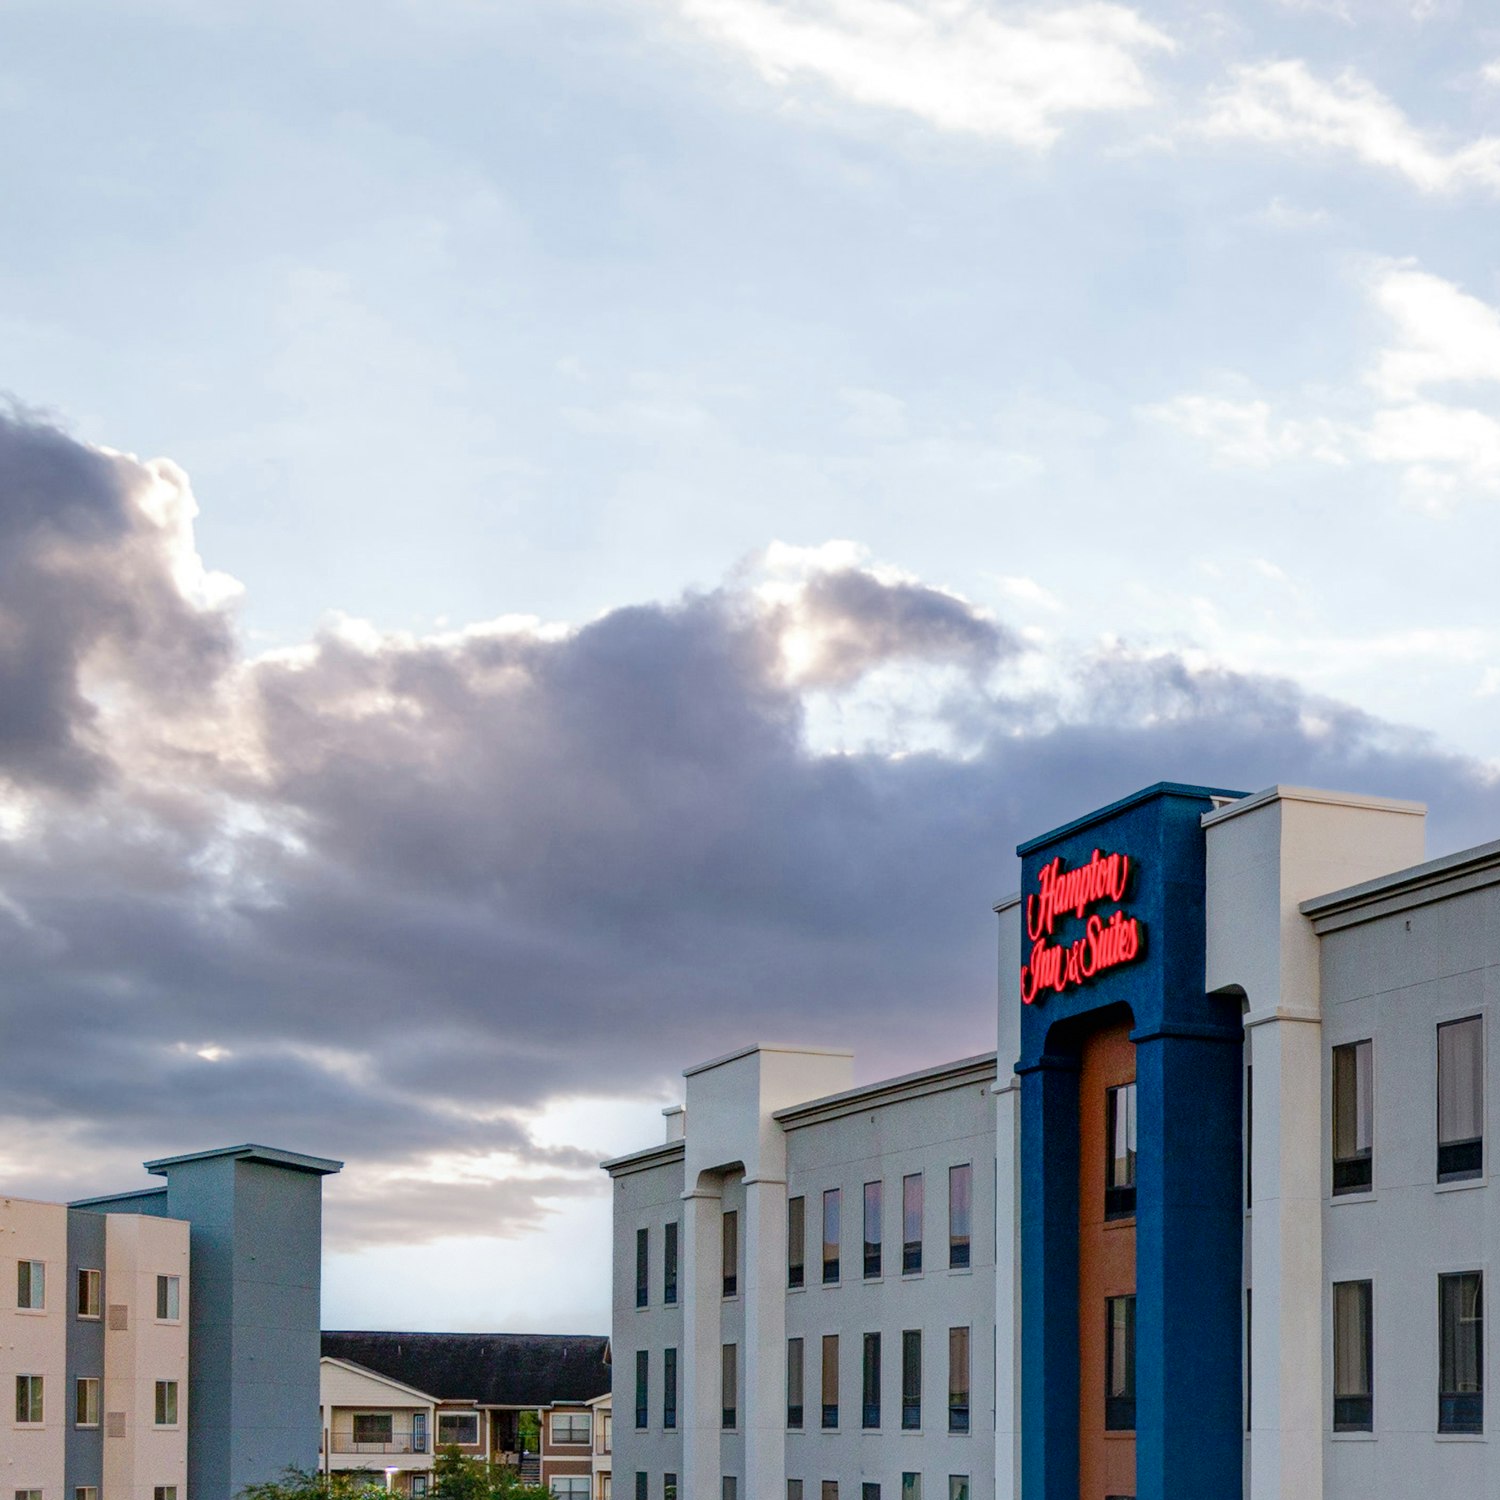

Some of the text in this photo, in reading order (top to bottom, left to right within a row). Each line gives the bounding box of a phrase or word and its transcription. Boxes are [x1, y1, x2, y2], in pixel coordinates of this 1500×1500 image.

[1027, 848, 1129, 941] Hampton
[1021, 909, 1139, 1005] Inn & Suites
